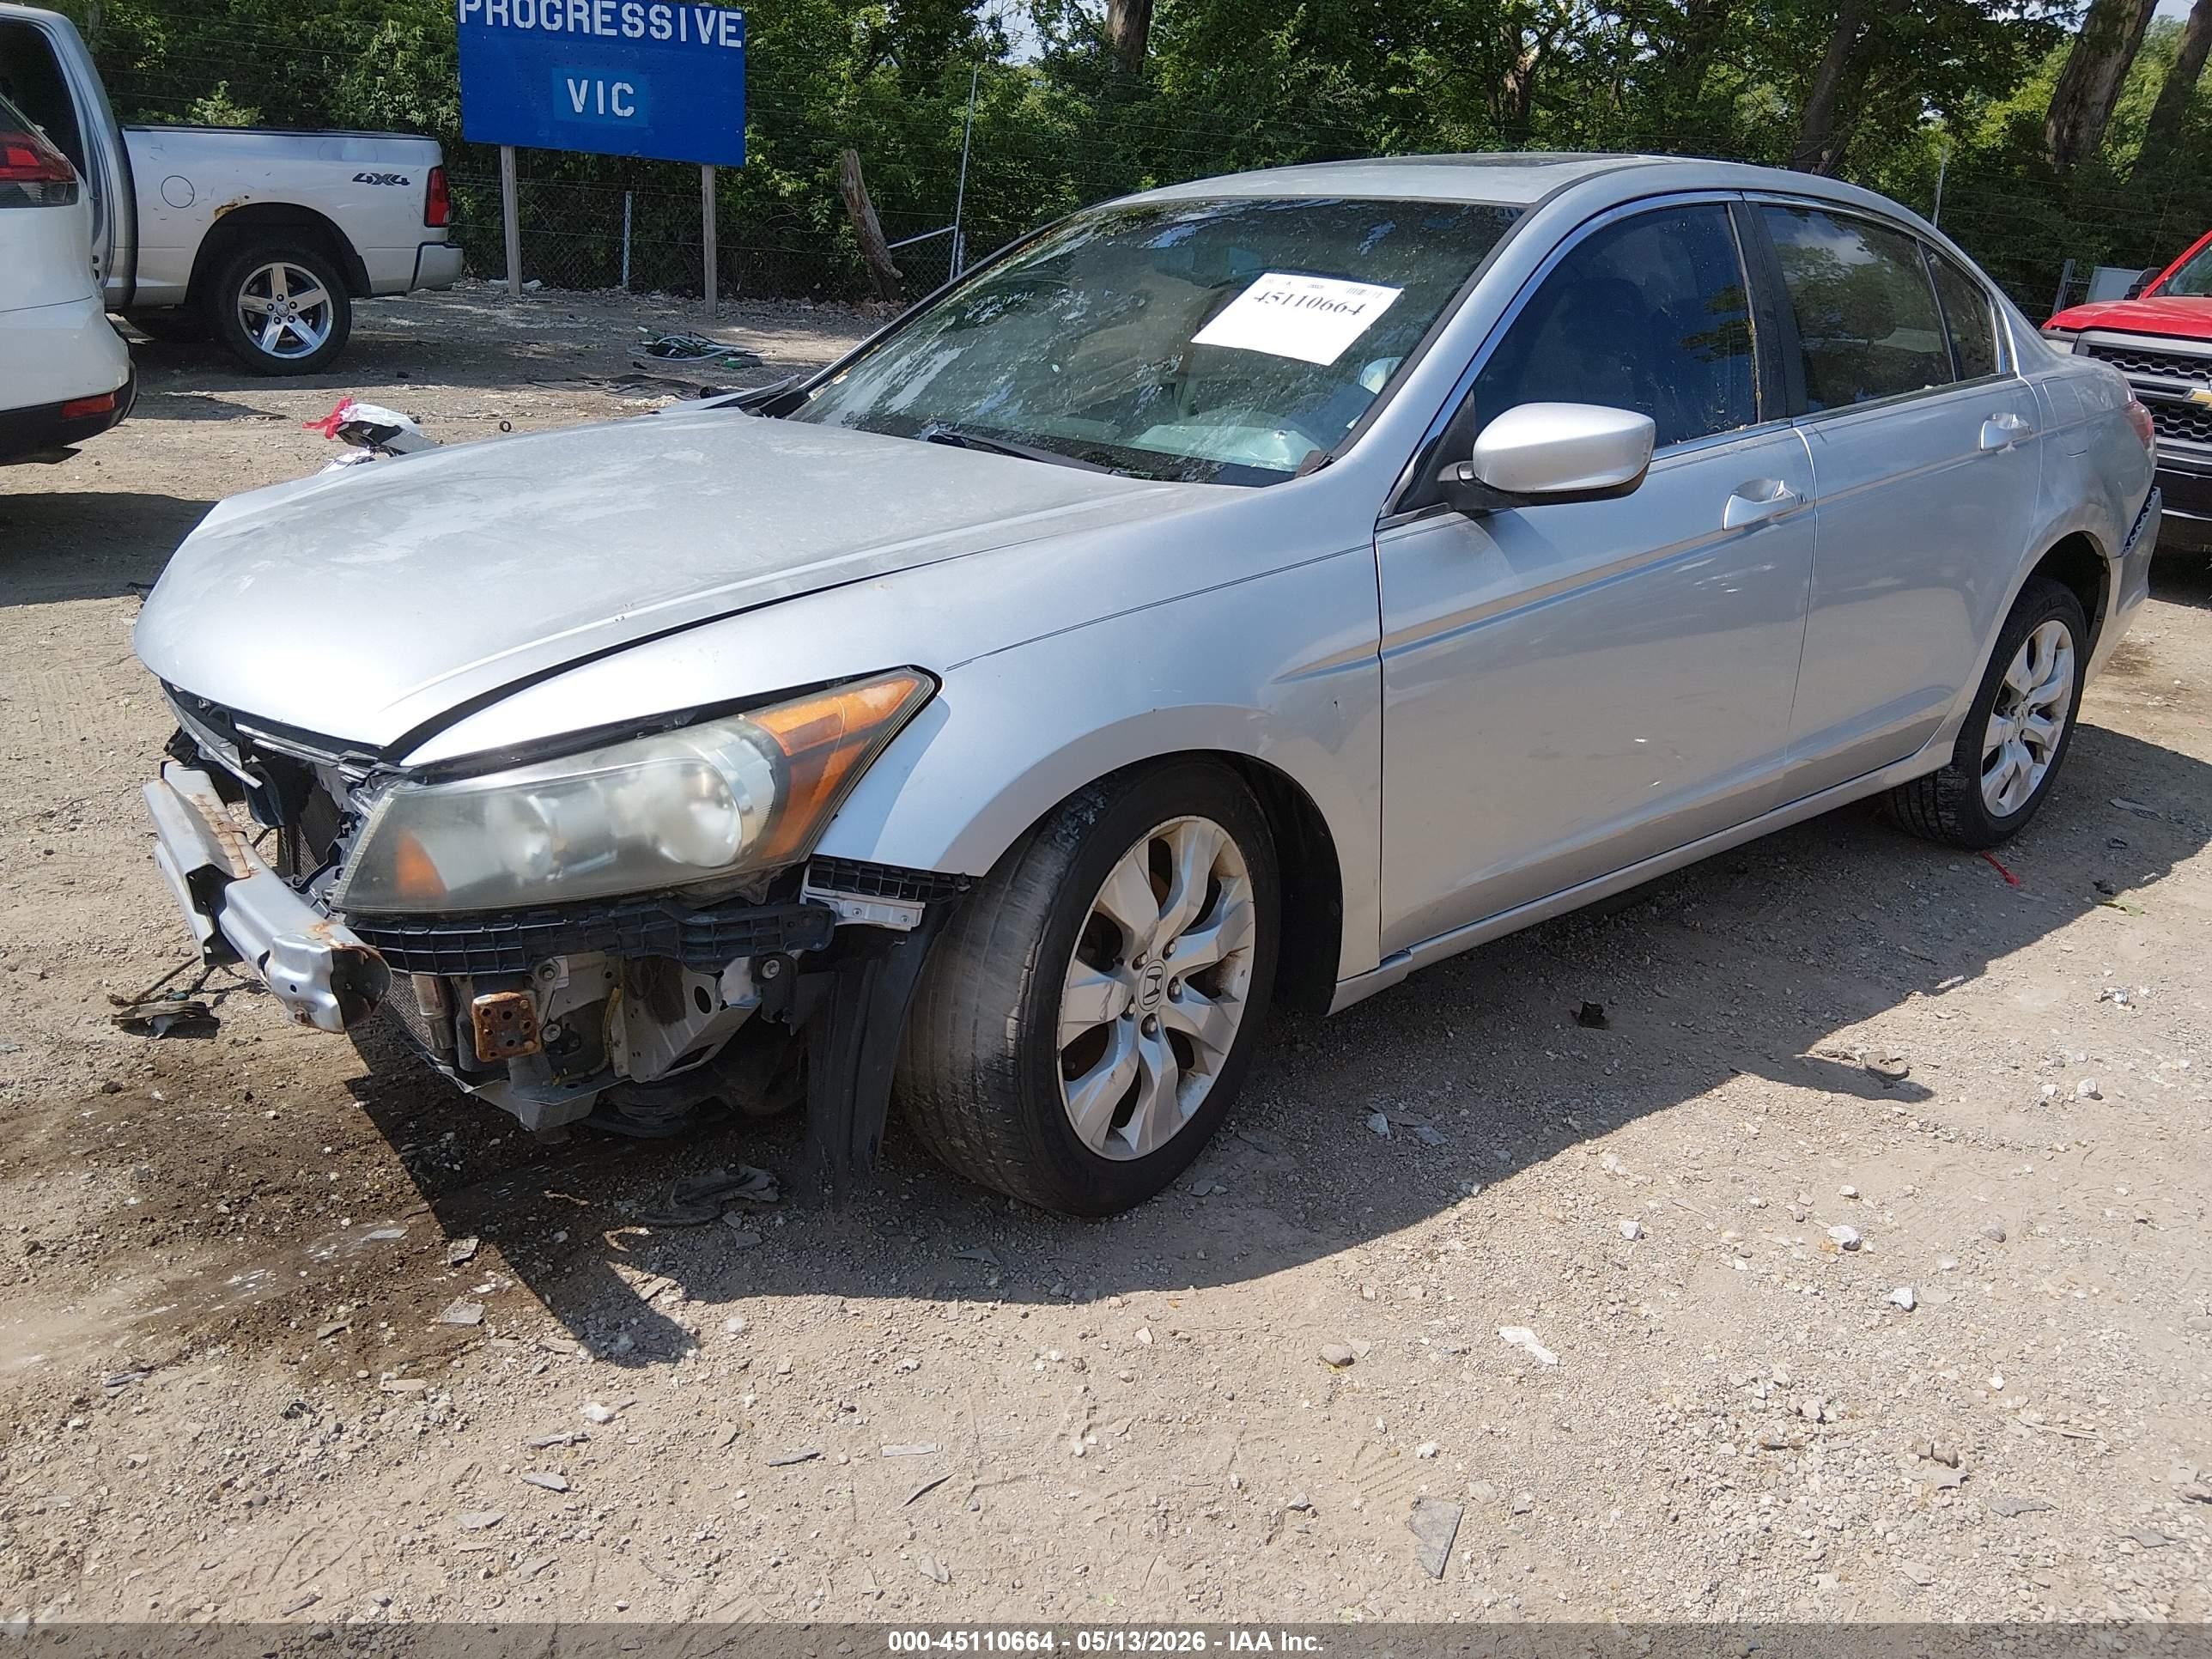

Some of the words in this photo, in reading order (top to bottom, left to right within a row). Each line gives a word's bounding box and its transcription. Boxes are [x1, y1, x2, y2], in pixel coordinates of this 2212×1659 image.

[459, 0, 742, 48] PROGRESSIVE
[567, 78, 635, 117] VIC
[1254, 291, 1366, 316] 45110664
